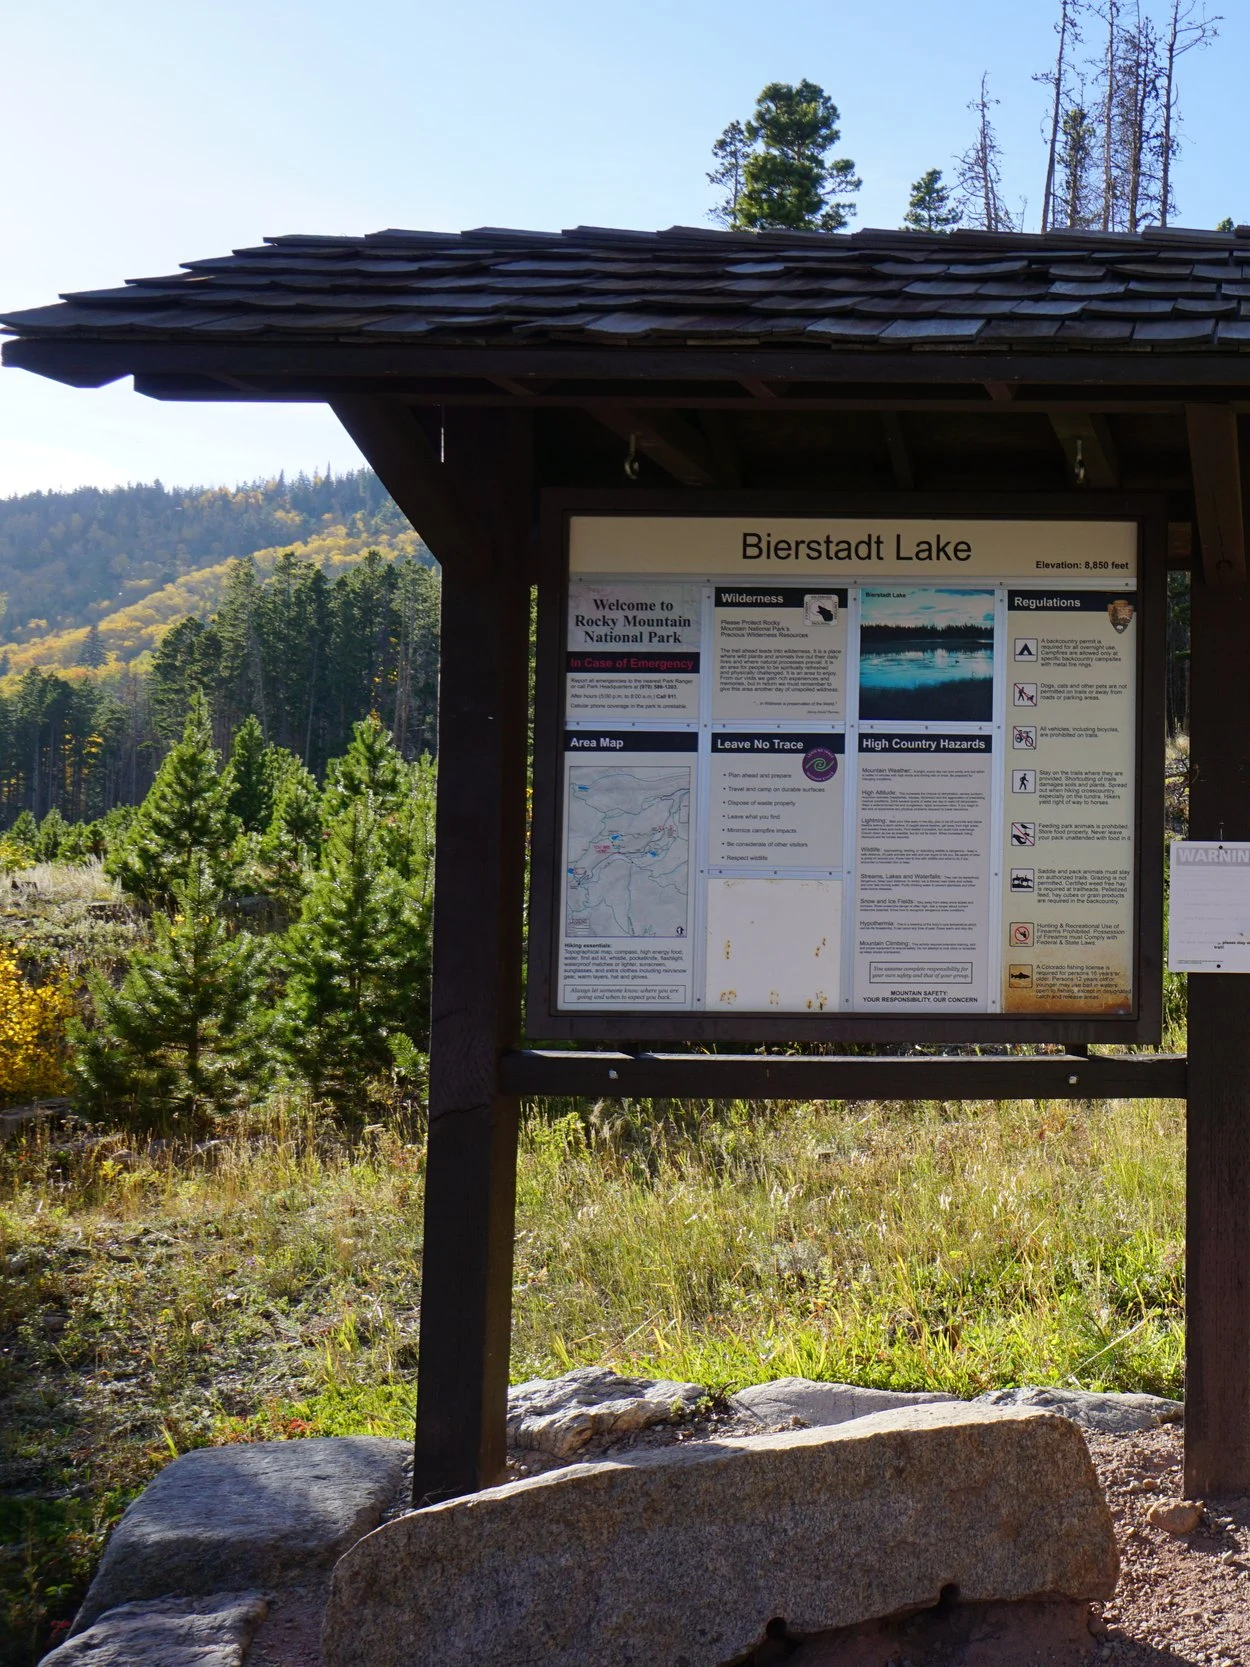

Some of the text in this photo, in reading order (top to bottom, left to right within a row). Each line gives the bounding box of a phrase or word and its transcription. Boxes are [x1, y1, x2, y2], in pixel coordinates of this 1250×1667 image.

[742, 532, 972, 561] Bierstadt Lake
[1036, 560, 1129, 571] Elevation: 8,850 feet
[721, 593, 784, 603] Wilderness
[1014, 597, 1080, 609] Regulations
[594, 598, 673, 611] Welcome to
[575, 614, 691, 630] Rocky Mountain
[584, 631, 682, 643] National Park
[570, 658, 693, 670] In Case of Emergency
[570, 737, 624, 750] Area Map
[717, 739, 804, 749] Leave No Trace
[863, 738, 986, 750] High Country Hazards
